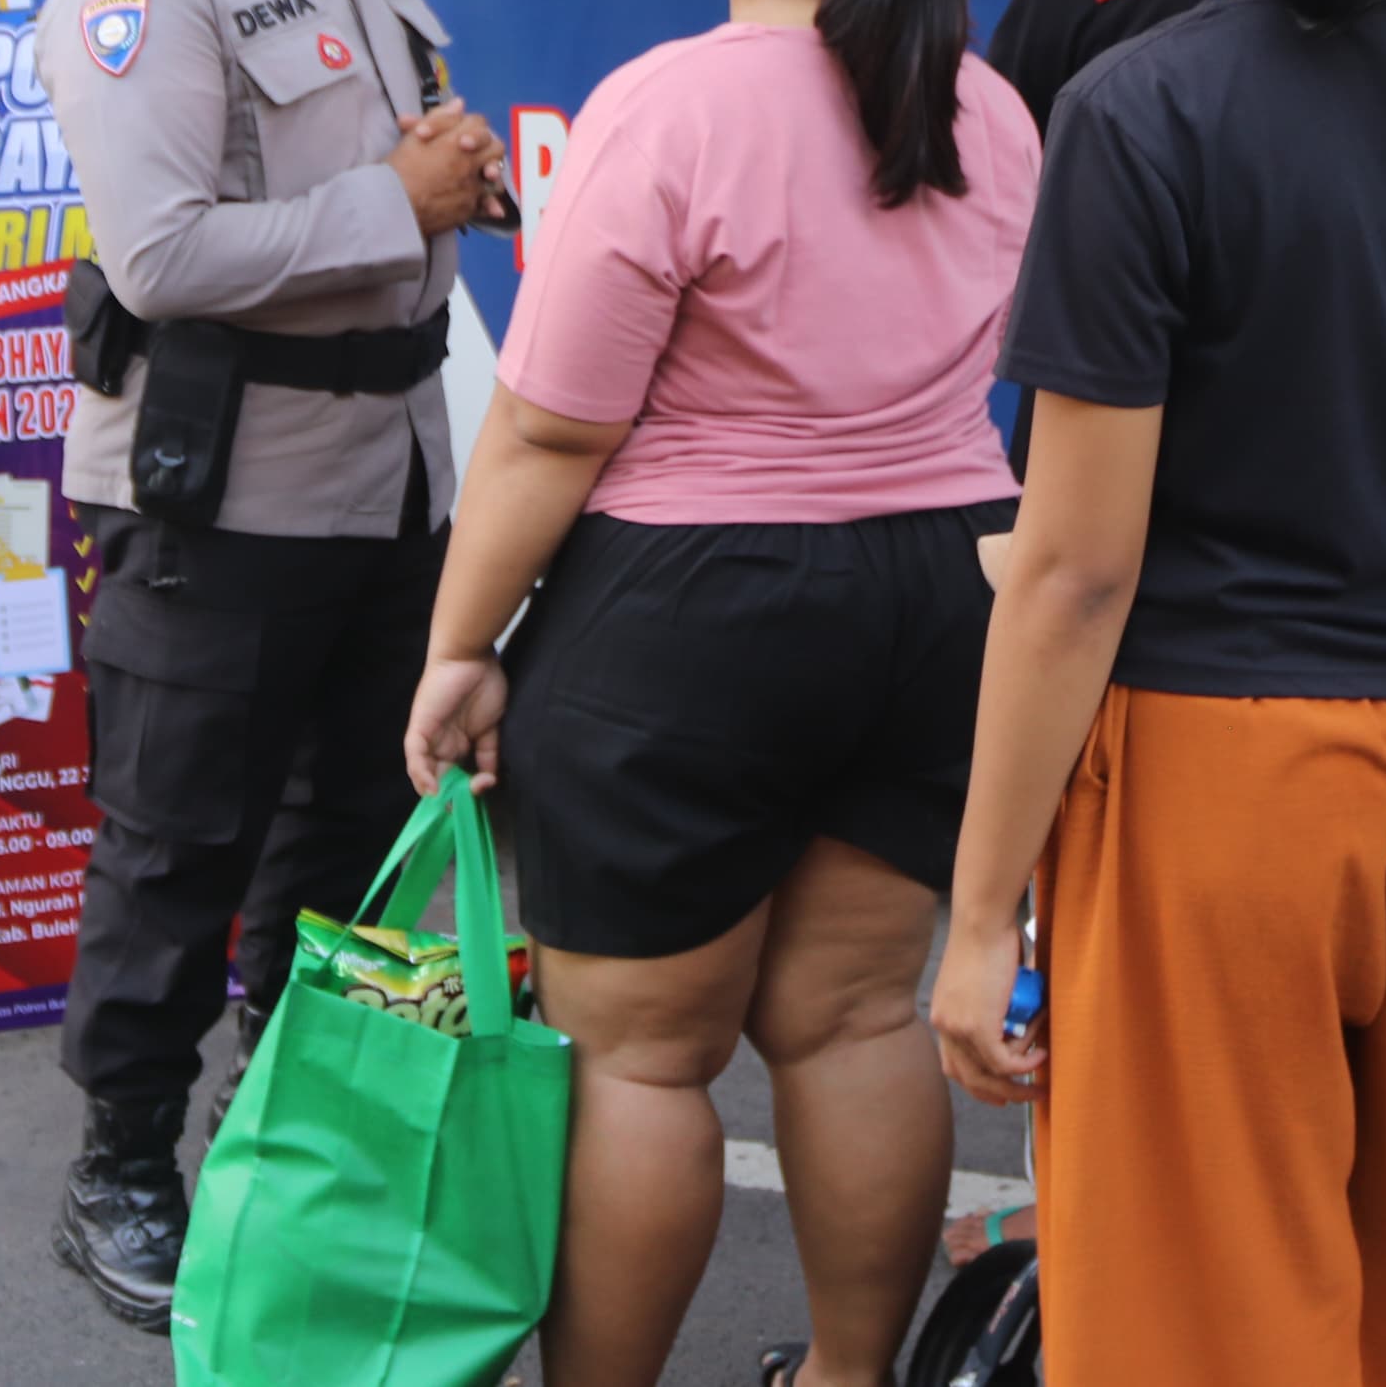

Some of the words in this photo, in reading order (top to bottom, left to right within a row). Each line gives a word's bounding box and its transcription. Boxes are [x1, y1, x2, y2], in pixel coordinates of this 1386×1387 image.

[58, 767, 80, 786] 22
[45, 828, 94, 849] 09.00
[9, 892, 75, 918] Ngurah
